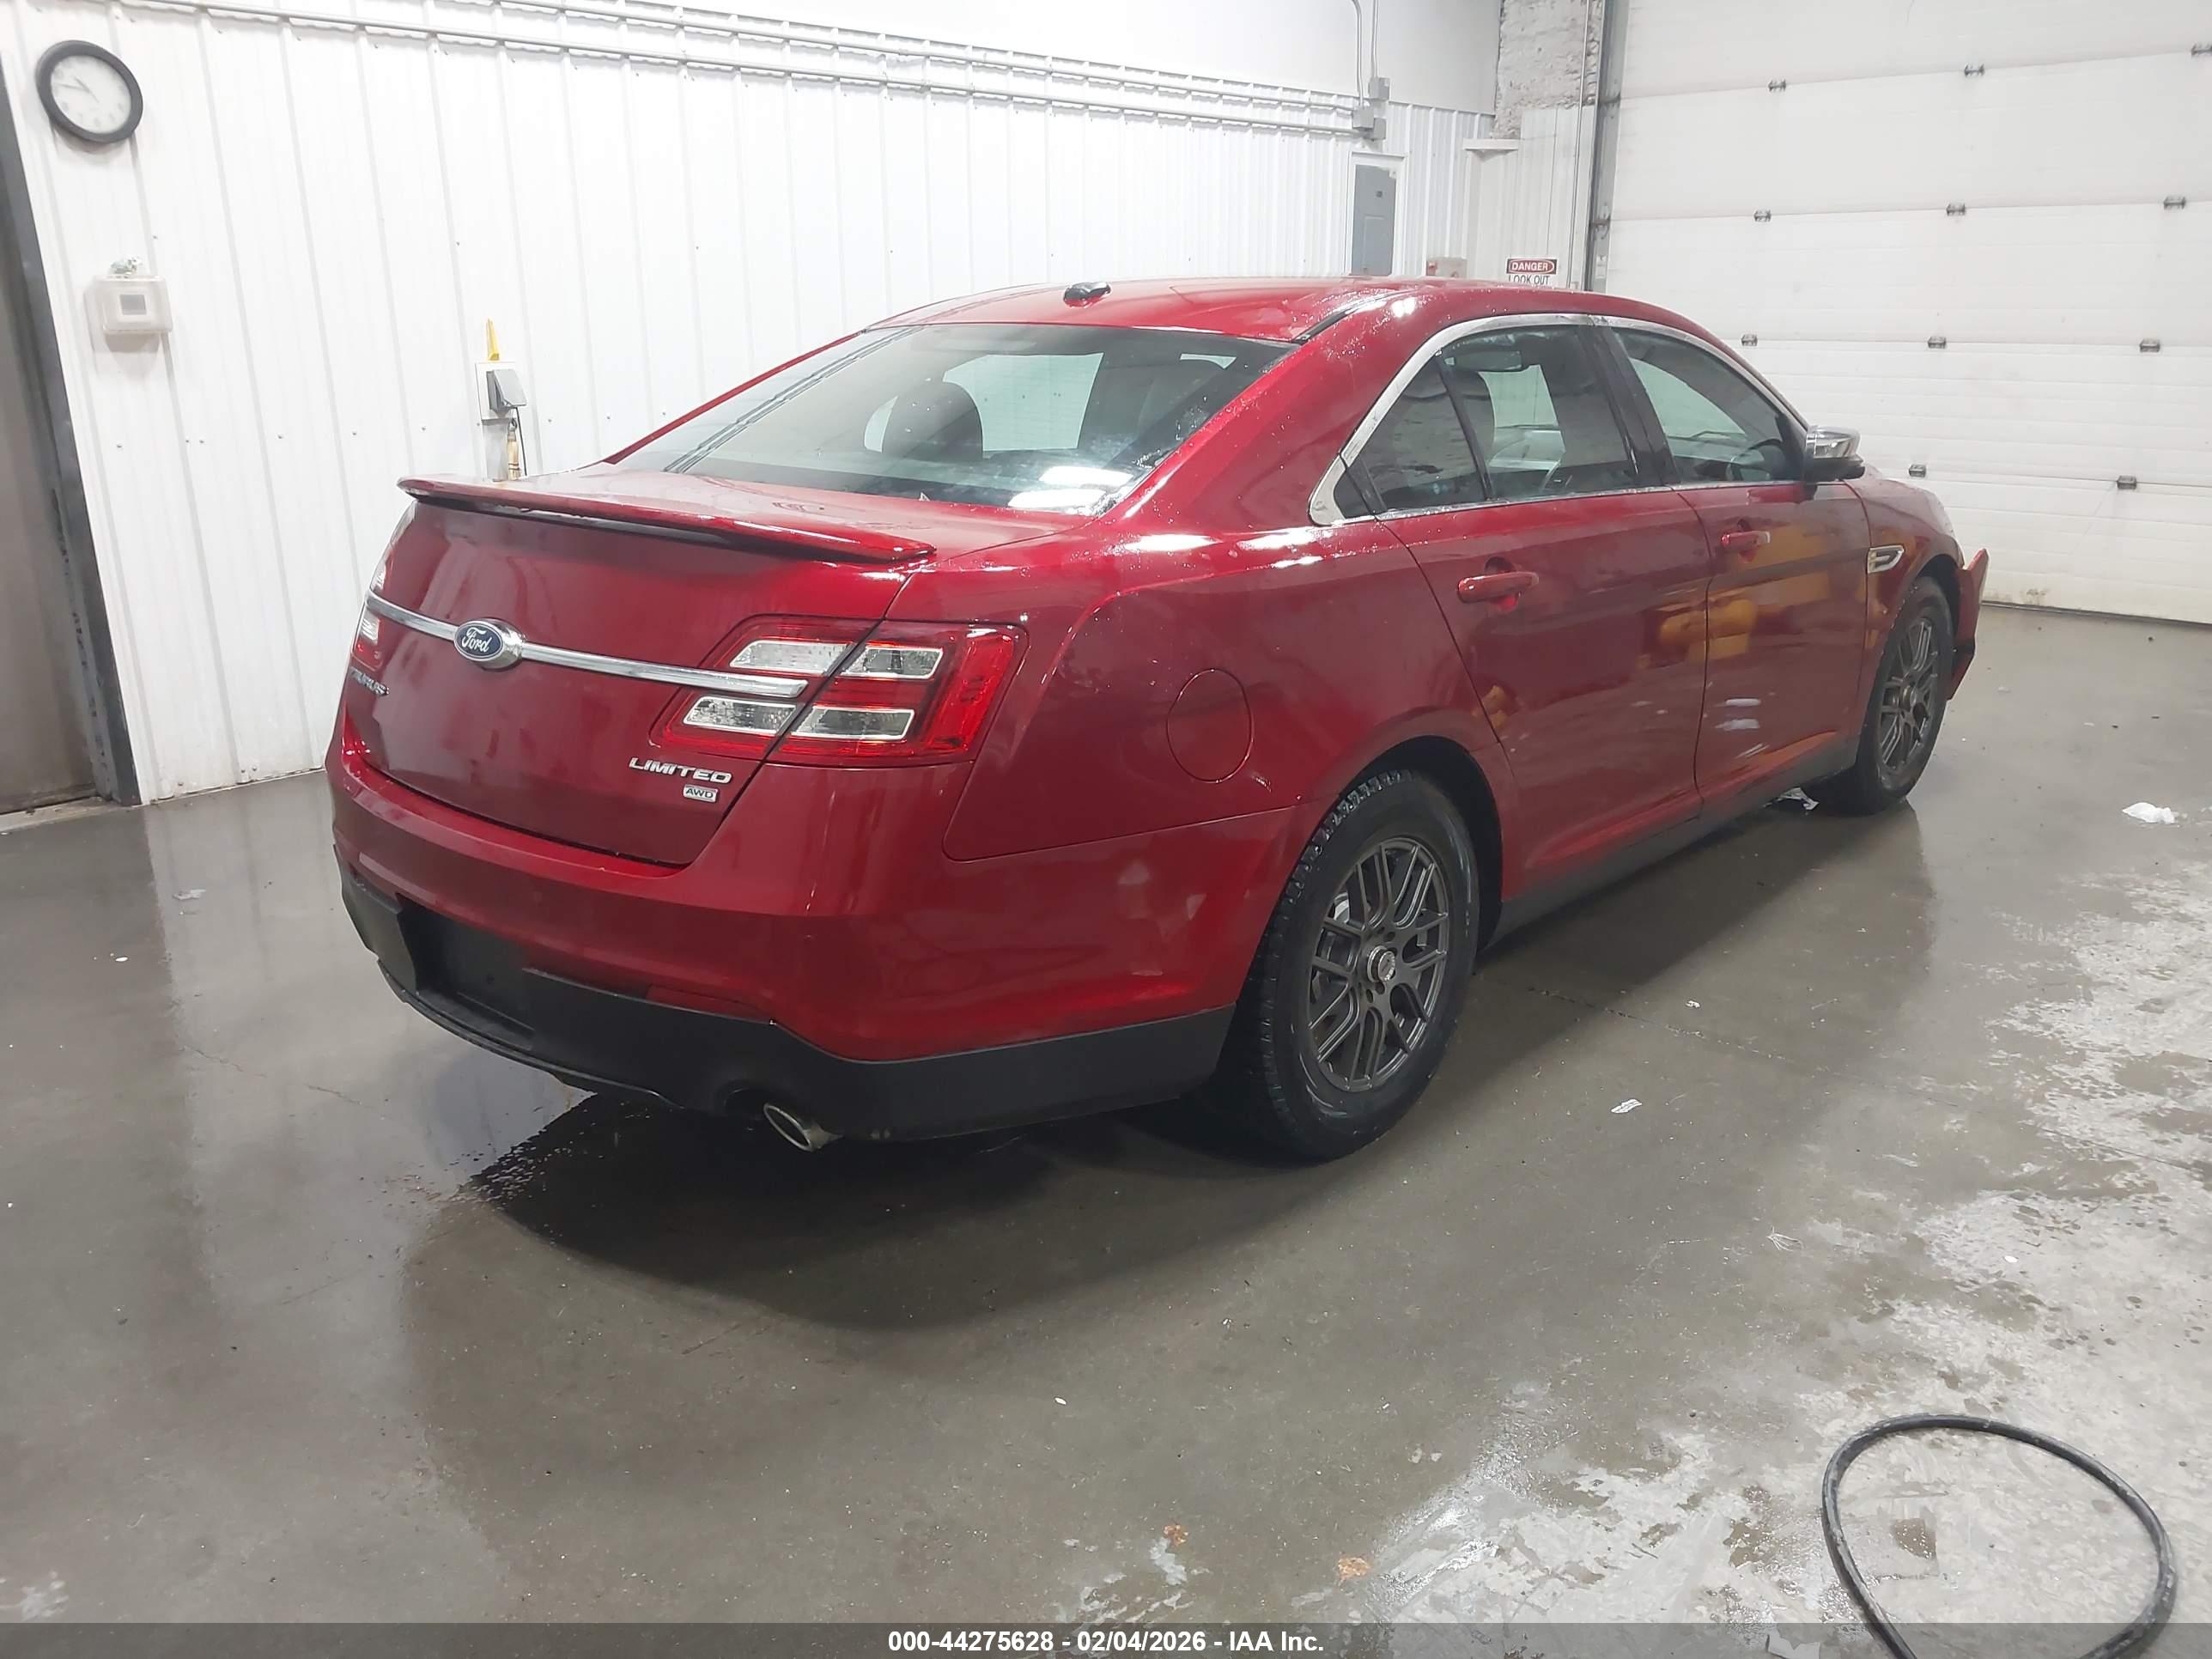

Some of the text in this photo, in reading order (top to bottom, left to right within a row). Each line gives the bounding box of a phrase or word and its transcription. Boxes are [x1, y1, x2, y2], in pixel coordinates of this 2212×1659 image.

[1511, 261, 1549, 271] DANGER
[1534, 275, 1551, 286] OUT
[461, 627, 493, 653] Ford
[629, 757, 732, 784] LIMITED
[685, 787, 714, 799] AWD
